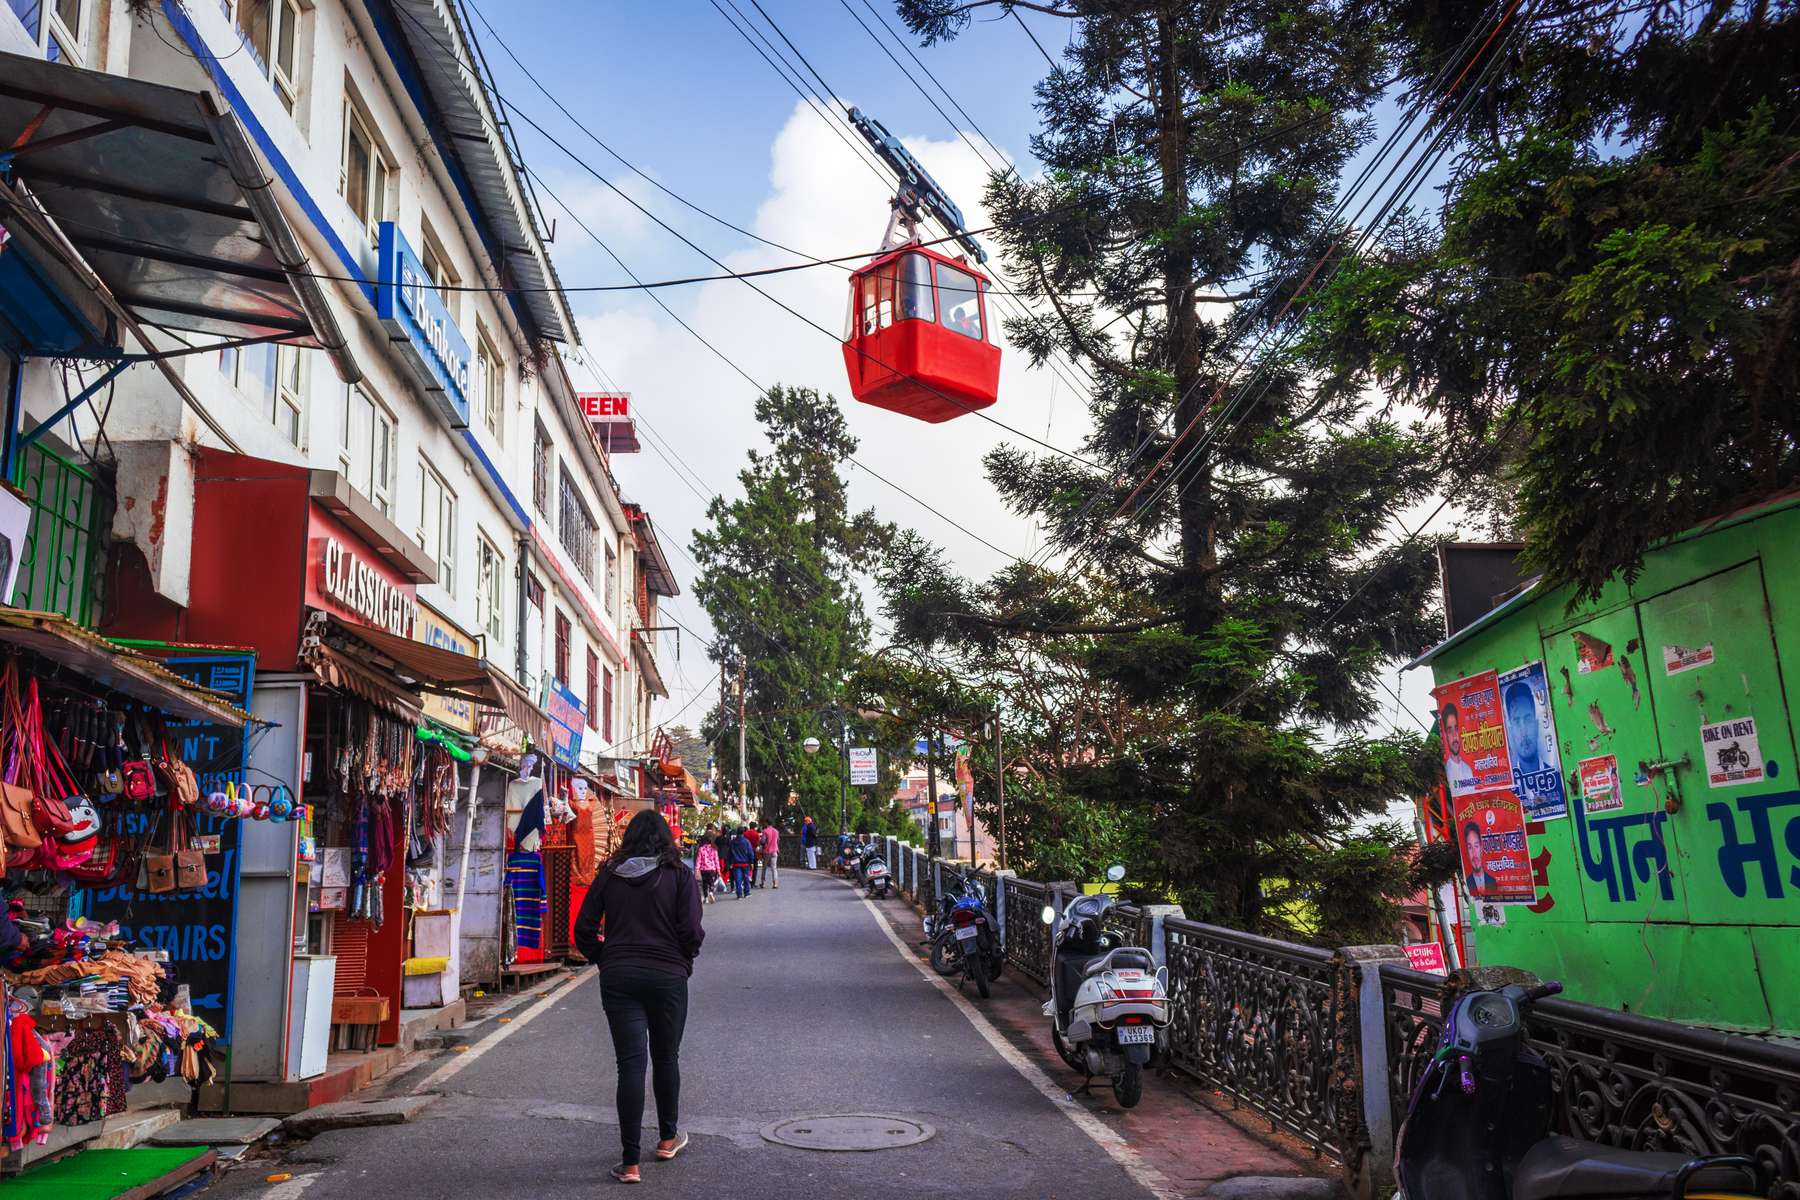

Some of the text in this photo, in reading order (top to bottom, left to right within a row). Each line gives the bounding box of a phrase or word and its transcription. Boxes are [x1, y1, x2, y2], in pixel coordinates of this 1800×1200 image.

[415, 272, 470, 401] Bunkotel
[579, 397, 628, 415] EEN
[325, 537, 421, 641] CLASSIC GIFT
[1702, 720, 1754, 743] BIKE ON RENT
[183, 732, 220, 763] N'T
[1513, 767, 1556, 797] ीपक
[1573, 798, 1675, 902] पान
[1706, 760, 1800, 899] भं
